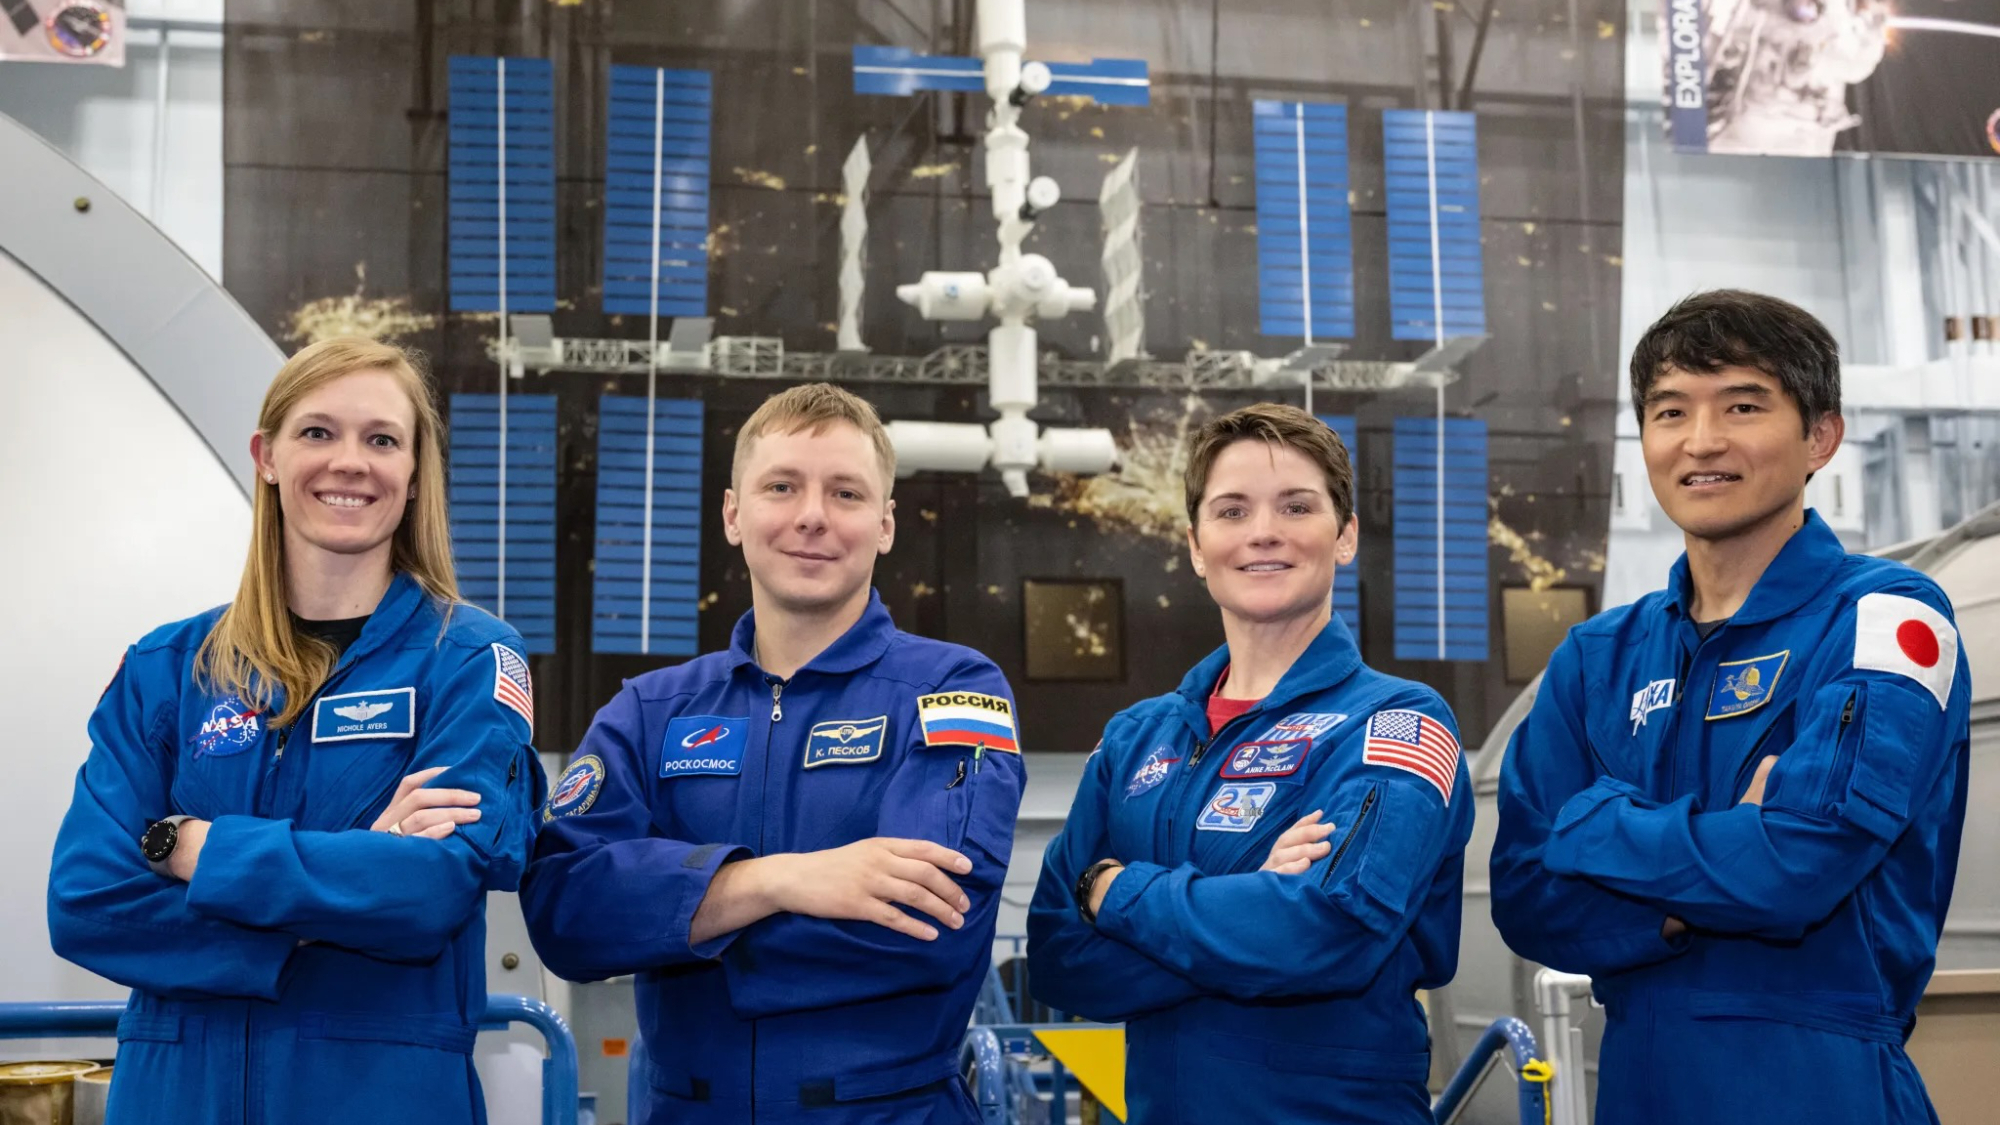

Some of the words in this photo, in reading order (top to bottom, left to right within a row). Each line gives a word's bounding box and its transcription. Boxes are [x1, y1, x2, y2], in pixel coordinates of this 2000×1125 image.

[1672, 0, 1702, 108] EXPLORA
[921, 694, 1009, 714] РОССИЯ
[200, 715, 259, 735] NASA
[337, 723, 364, 733] NICHOLE
[367, 722, 388, 731] AYERS
[815, 747, 825, 758] К.
[827, 745, 871, 756] ПЕСКОВ
[665, 759, 737, 772] РОСКОСМОС
[1244, 766, 1264, 774] ANNE
